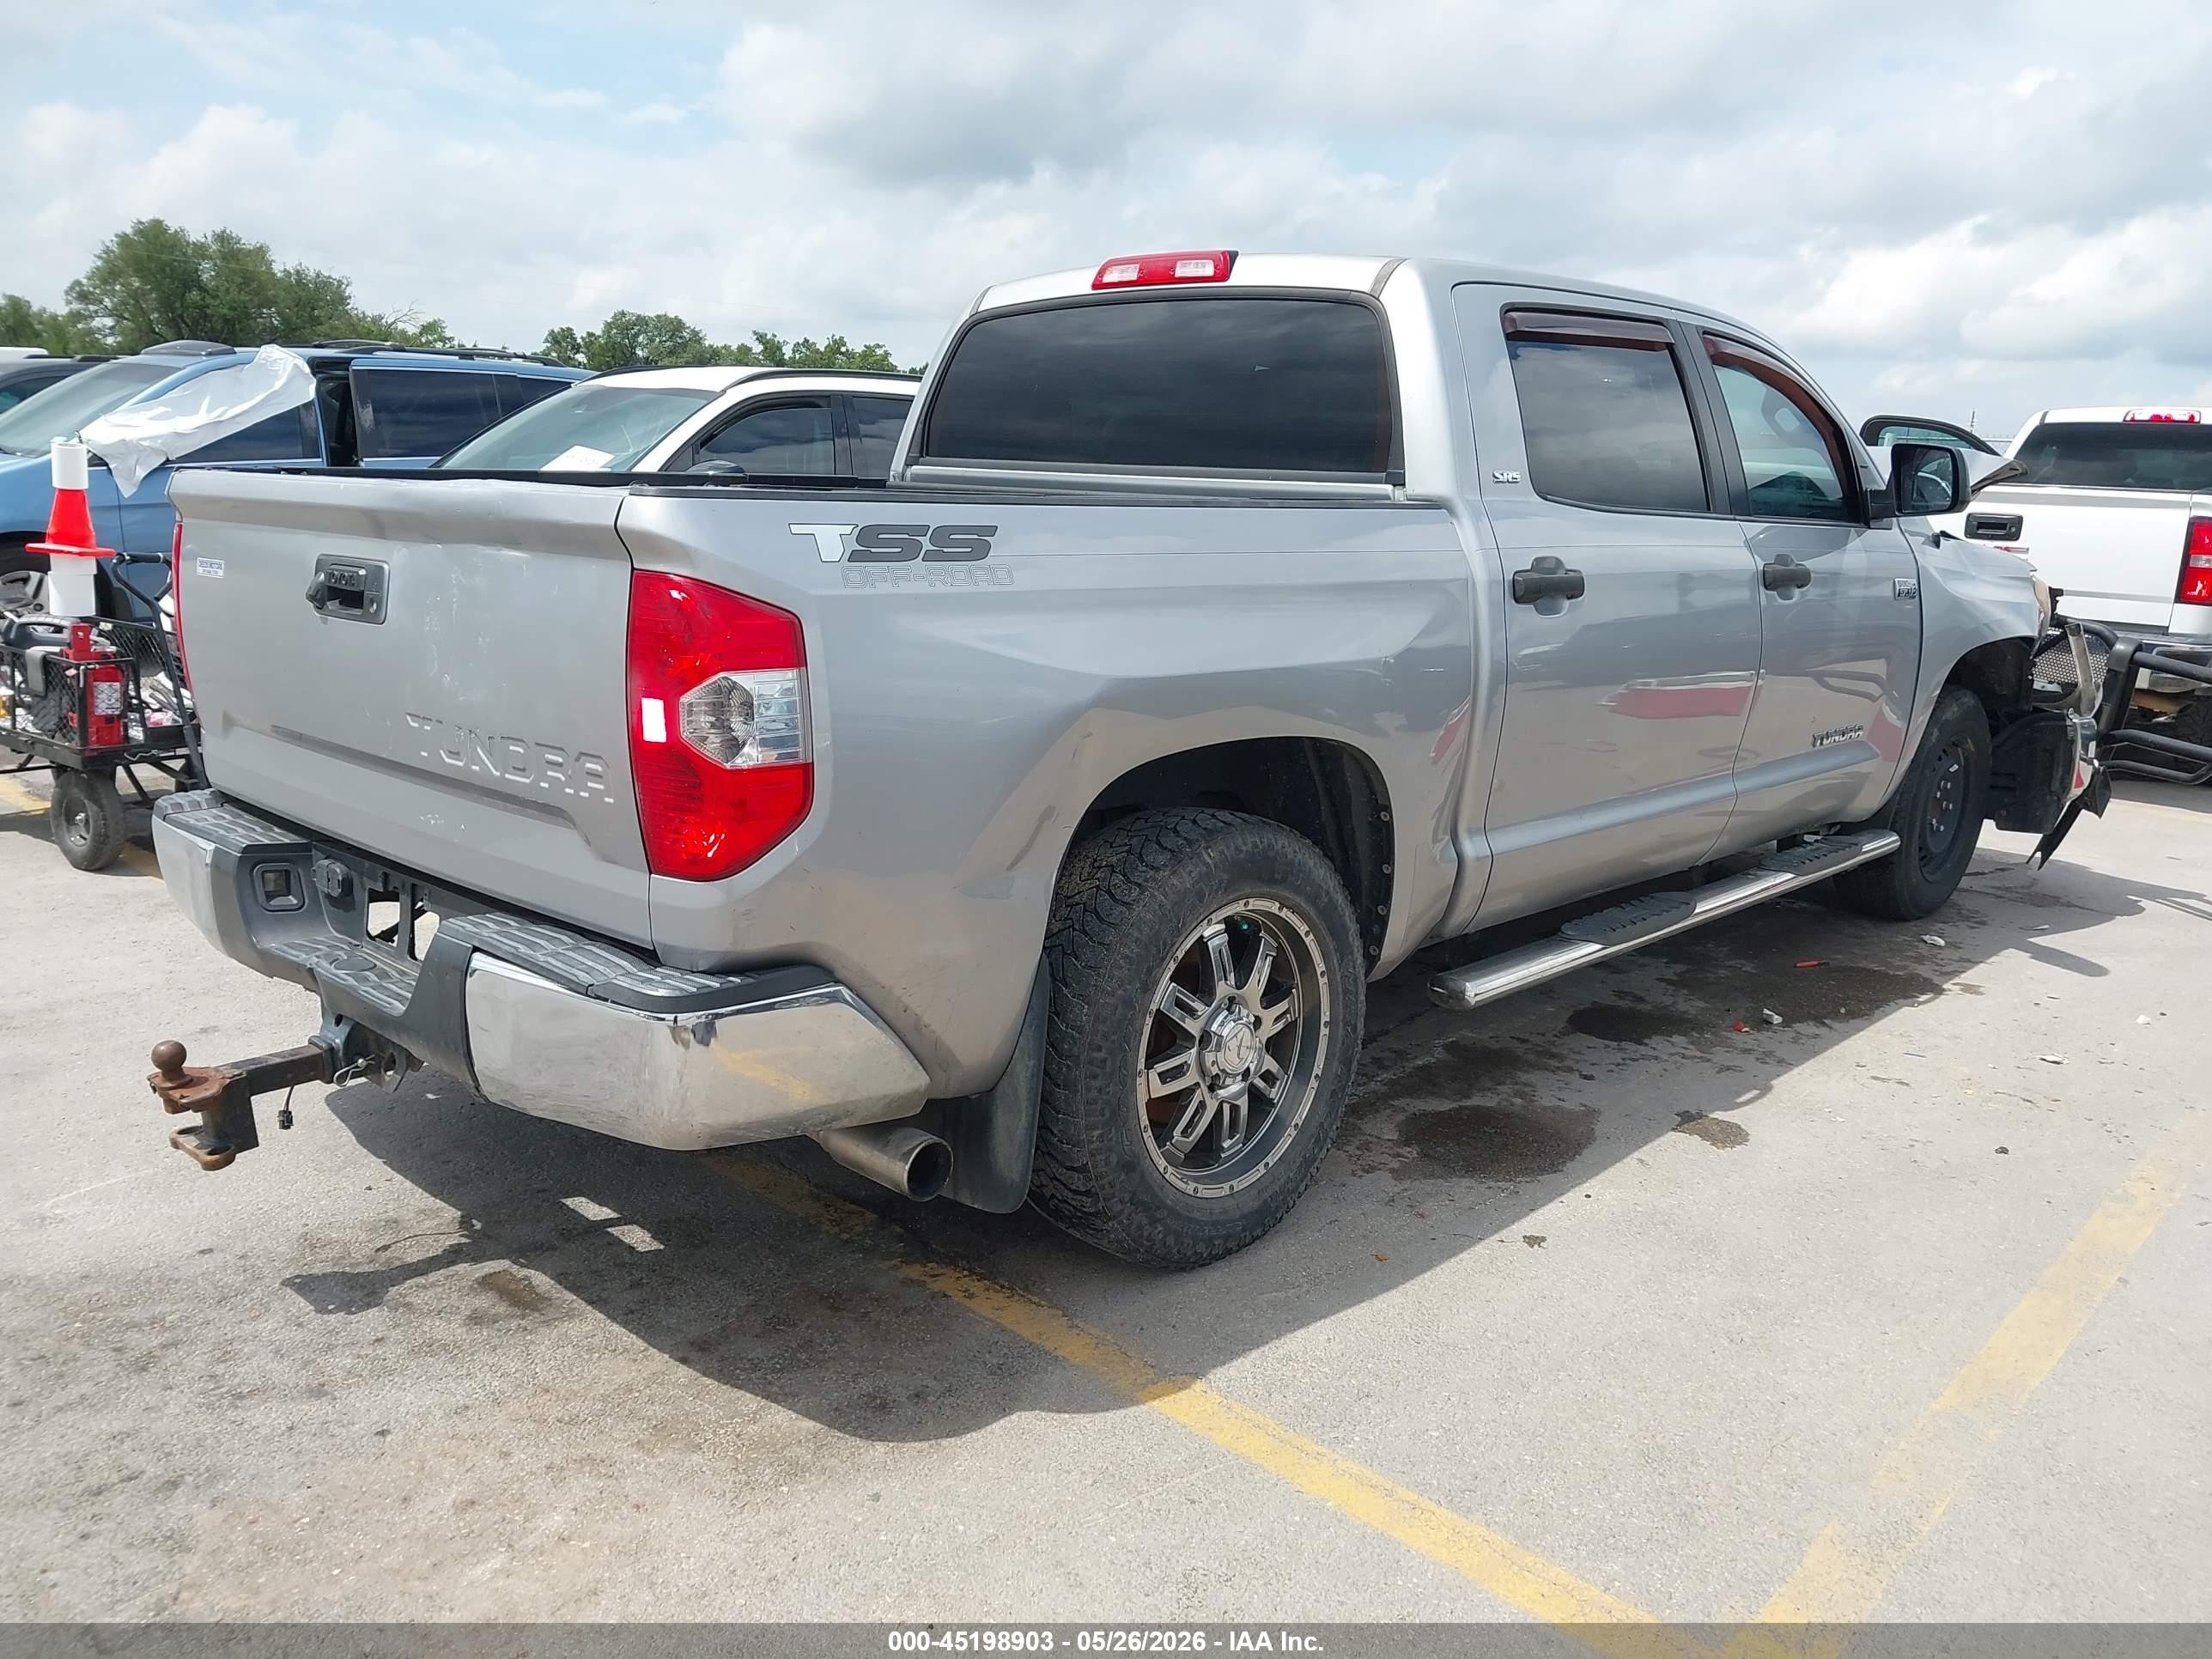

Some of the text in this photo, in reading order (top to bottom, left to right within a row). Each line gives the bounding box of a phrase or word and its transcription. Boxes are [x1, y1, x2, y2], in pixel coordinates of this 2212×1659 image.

[787, 523, 998, 562] TSS
[842, 564, 1014, 589] OFF-ROAD
[1812, 724, 1864, 748] TUNDRA
[405, 712, 616, 805] TUNDRA
